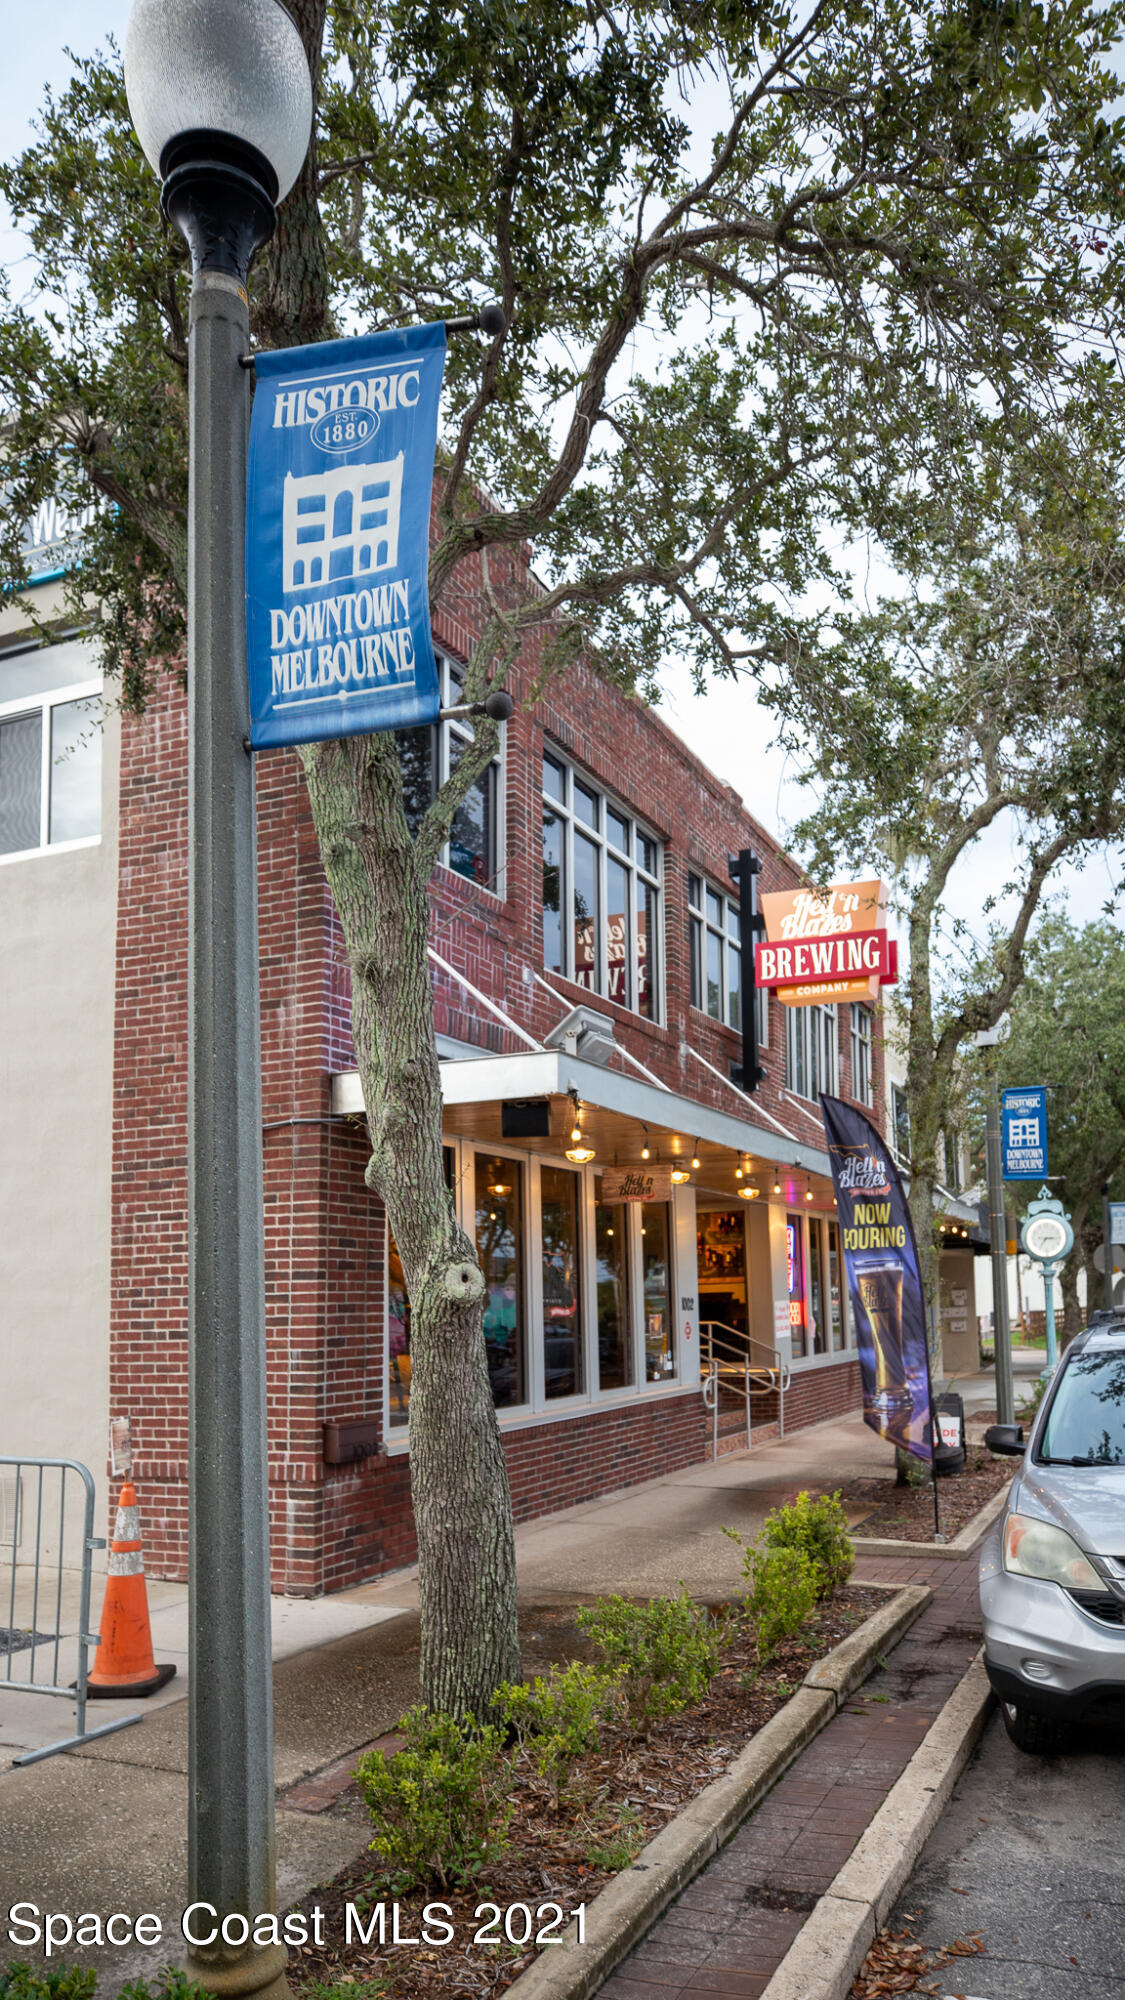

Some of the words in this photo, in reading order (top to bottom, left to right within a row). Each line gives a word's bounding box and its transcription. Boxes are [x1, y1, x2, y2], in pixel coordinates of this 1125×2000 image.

[272, 369, 421, 429] HISTORIC
[335, 411, 358, 424] EST.
[323, 420, 369, 444] 1880
[269, 578, 411, 650] DOWNTOWN
[271, 627, 416, 695] MELBOURNE
[780, 912, 853, 941] Blazes
[760, 936, 881, 981] BREWING
[796, 982, 849, 996] COMPANY
[838, 1171, 886, 1189] Blazes
[854, 1202, 892, 1226] NOW
